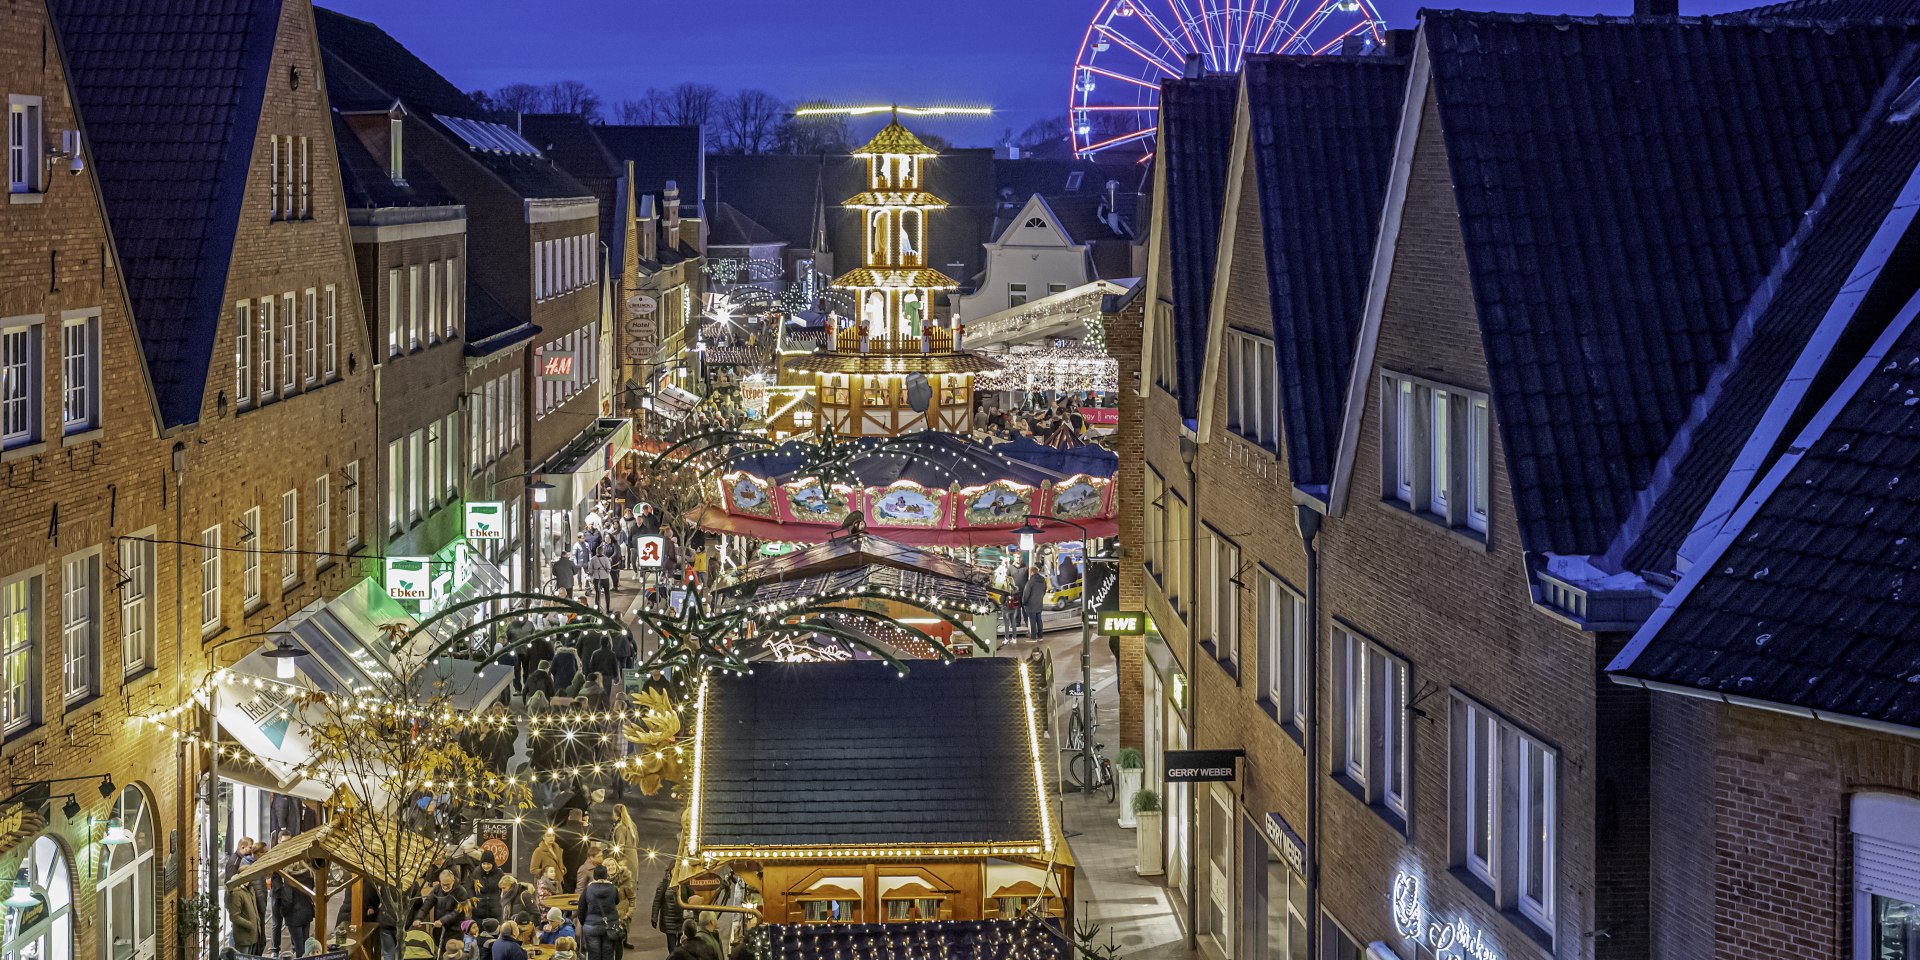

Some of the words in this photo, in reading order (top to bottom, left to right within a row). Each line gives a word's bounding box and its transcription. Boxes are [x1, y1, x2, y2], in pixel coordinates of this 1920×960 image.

[545, 357, 572, 375] H&M
[469, 529, 500, 537] Ebken
[390, 588, 425, 598] Ebken
[1088, 573, 1117, 613] Kristin
[1104, 618, 1137, 631] EWE
[1168, 768, 1199, 777] GERRY
[1200, 767, 1232, 777] WEBER
[1266, 813, 1283, 846] GERRY
[1282, 831, 1302, 874] WEBER
